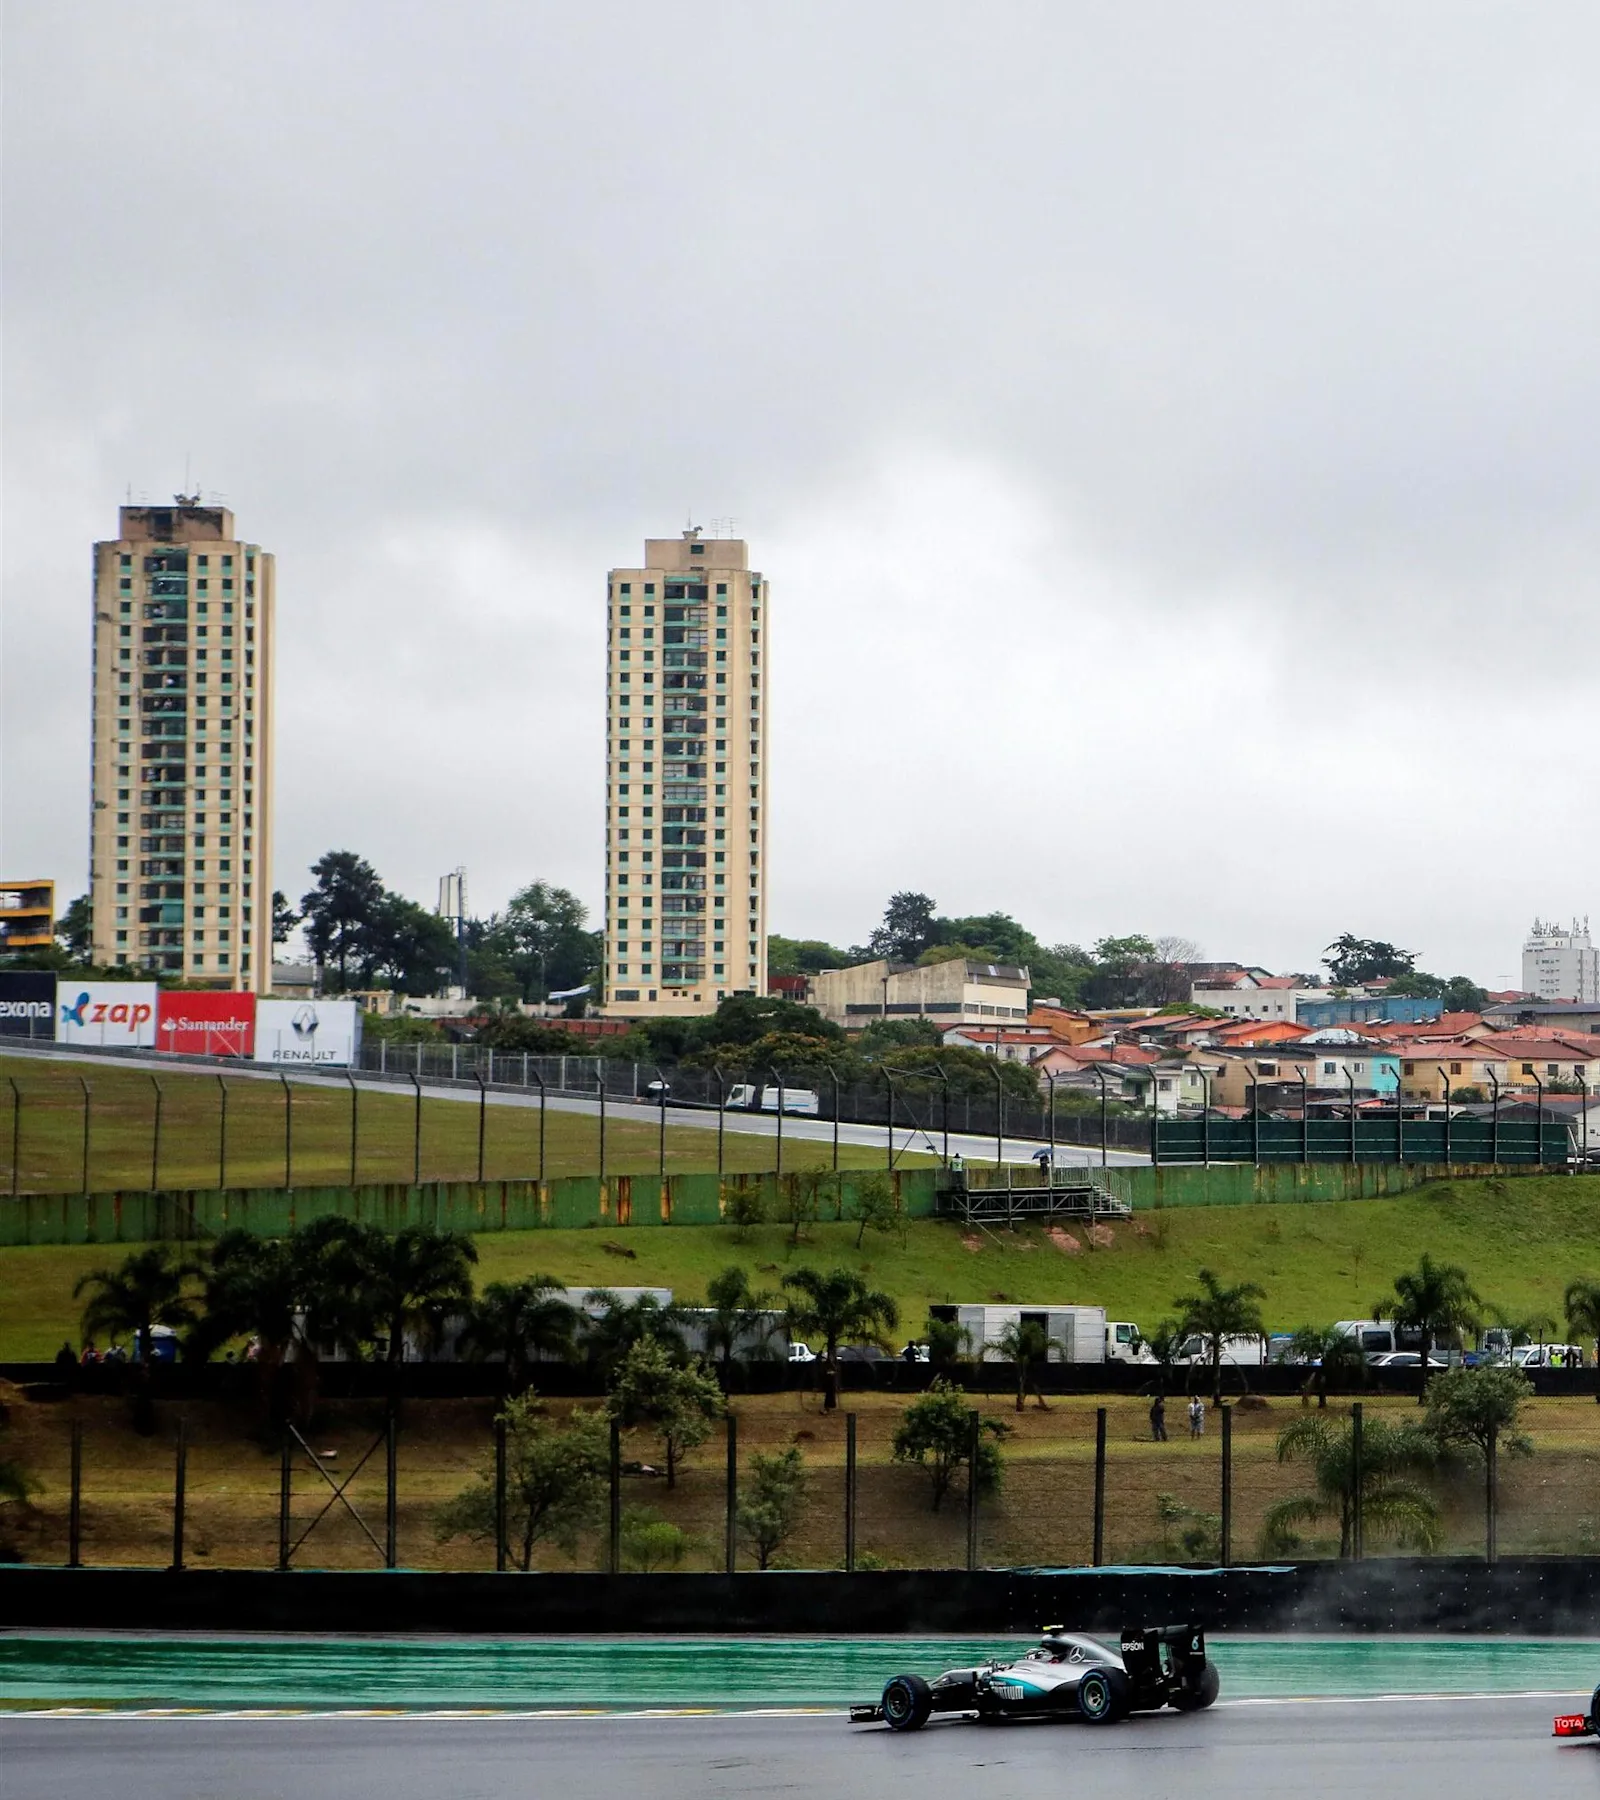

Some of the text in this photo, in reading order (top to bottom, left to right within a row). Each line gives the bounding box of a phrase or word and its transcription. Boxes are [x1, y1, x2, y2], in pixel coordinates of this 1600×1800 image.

[90, 1004, 151, 1032] zap
[178, 1016, 249, 1031] Santander
[1121, 1641, 1144, 1652] EPSON
[1191, 1635, 1200, 1650] 6
